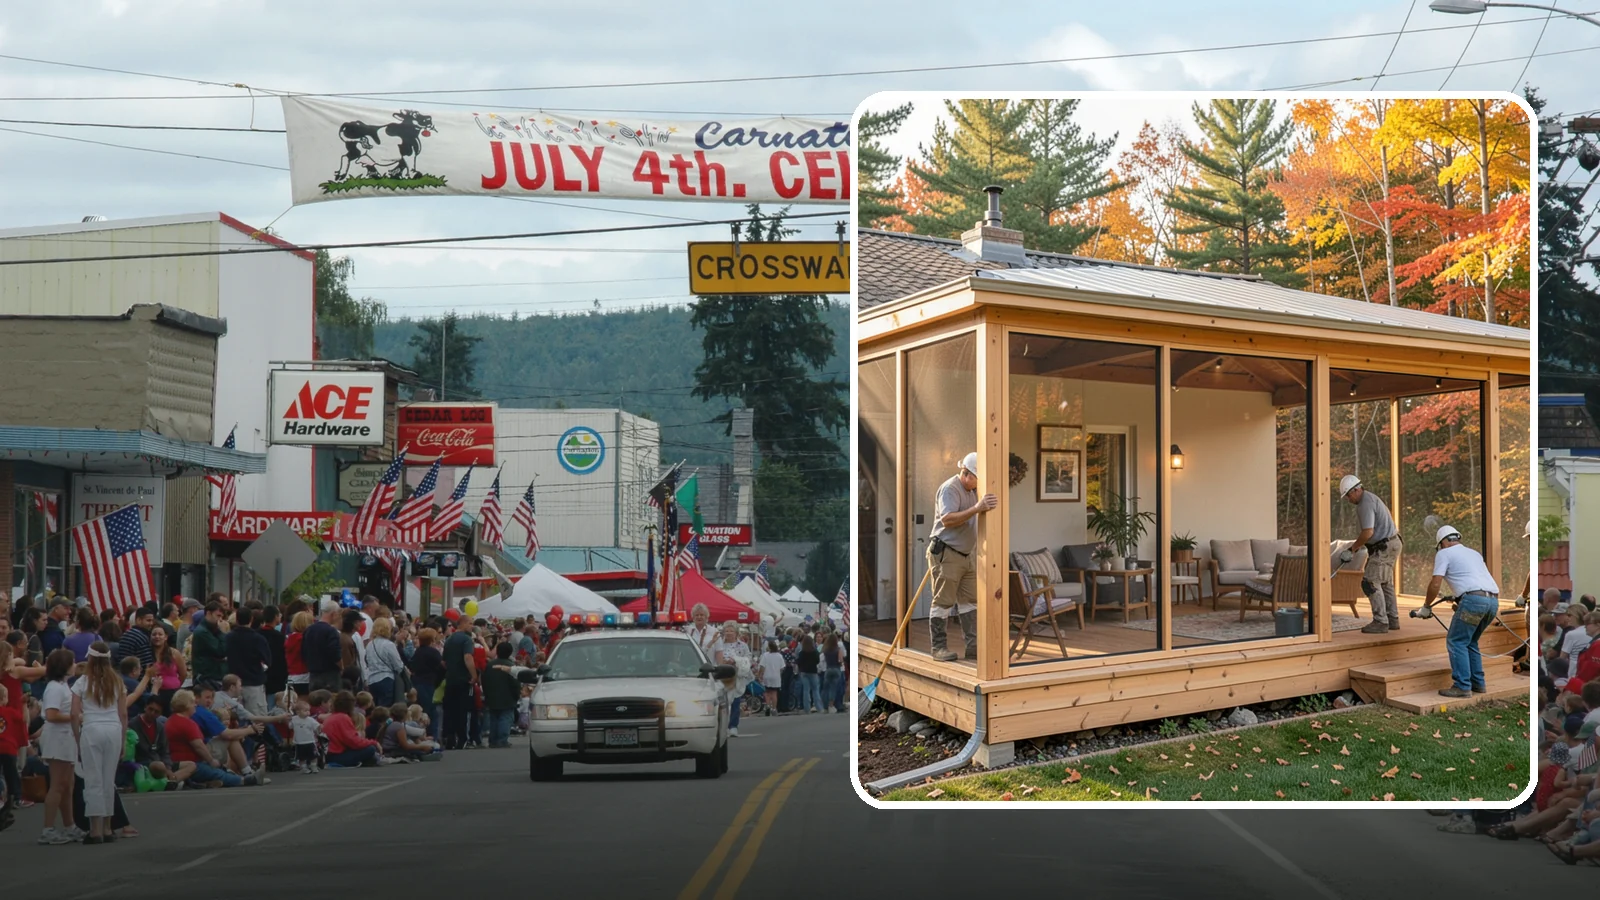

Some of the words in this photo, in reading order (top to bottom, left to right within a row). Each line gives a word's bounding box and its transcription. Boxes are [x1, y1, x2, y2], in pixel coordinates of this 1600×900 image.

[695, 121, 850, 149] Carnat
[481, 141, 605, 192] JULY
[632, 150, 746, 197] 4th.
[697, 254, 850, 280] CROSSWA
[282, 380, 373, 420] ACE
[405, 409, 453, 422] CEDAR
[460, 409, 485, 422] LOG
[283, 421, 371, 437] Hardware
[354, 467, 386, 479] Simpl
[83, 485, 93, 495] St.
[95, 485, 125, 495] Vincent
[126, 486, 136, 495] de
[137, 485, 155, 495] Paul
[81, 503, 154, 522] THRT
[212, 516, 331, 535] HARDARE
[688, 526, 742, 535] CRNATION
[699, 535, 730, 544] GLASS
